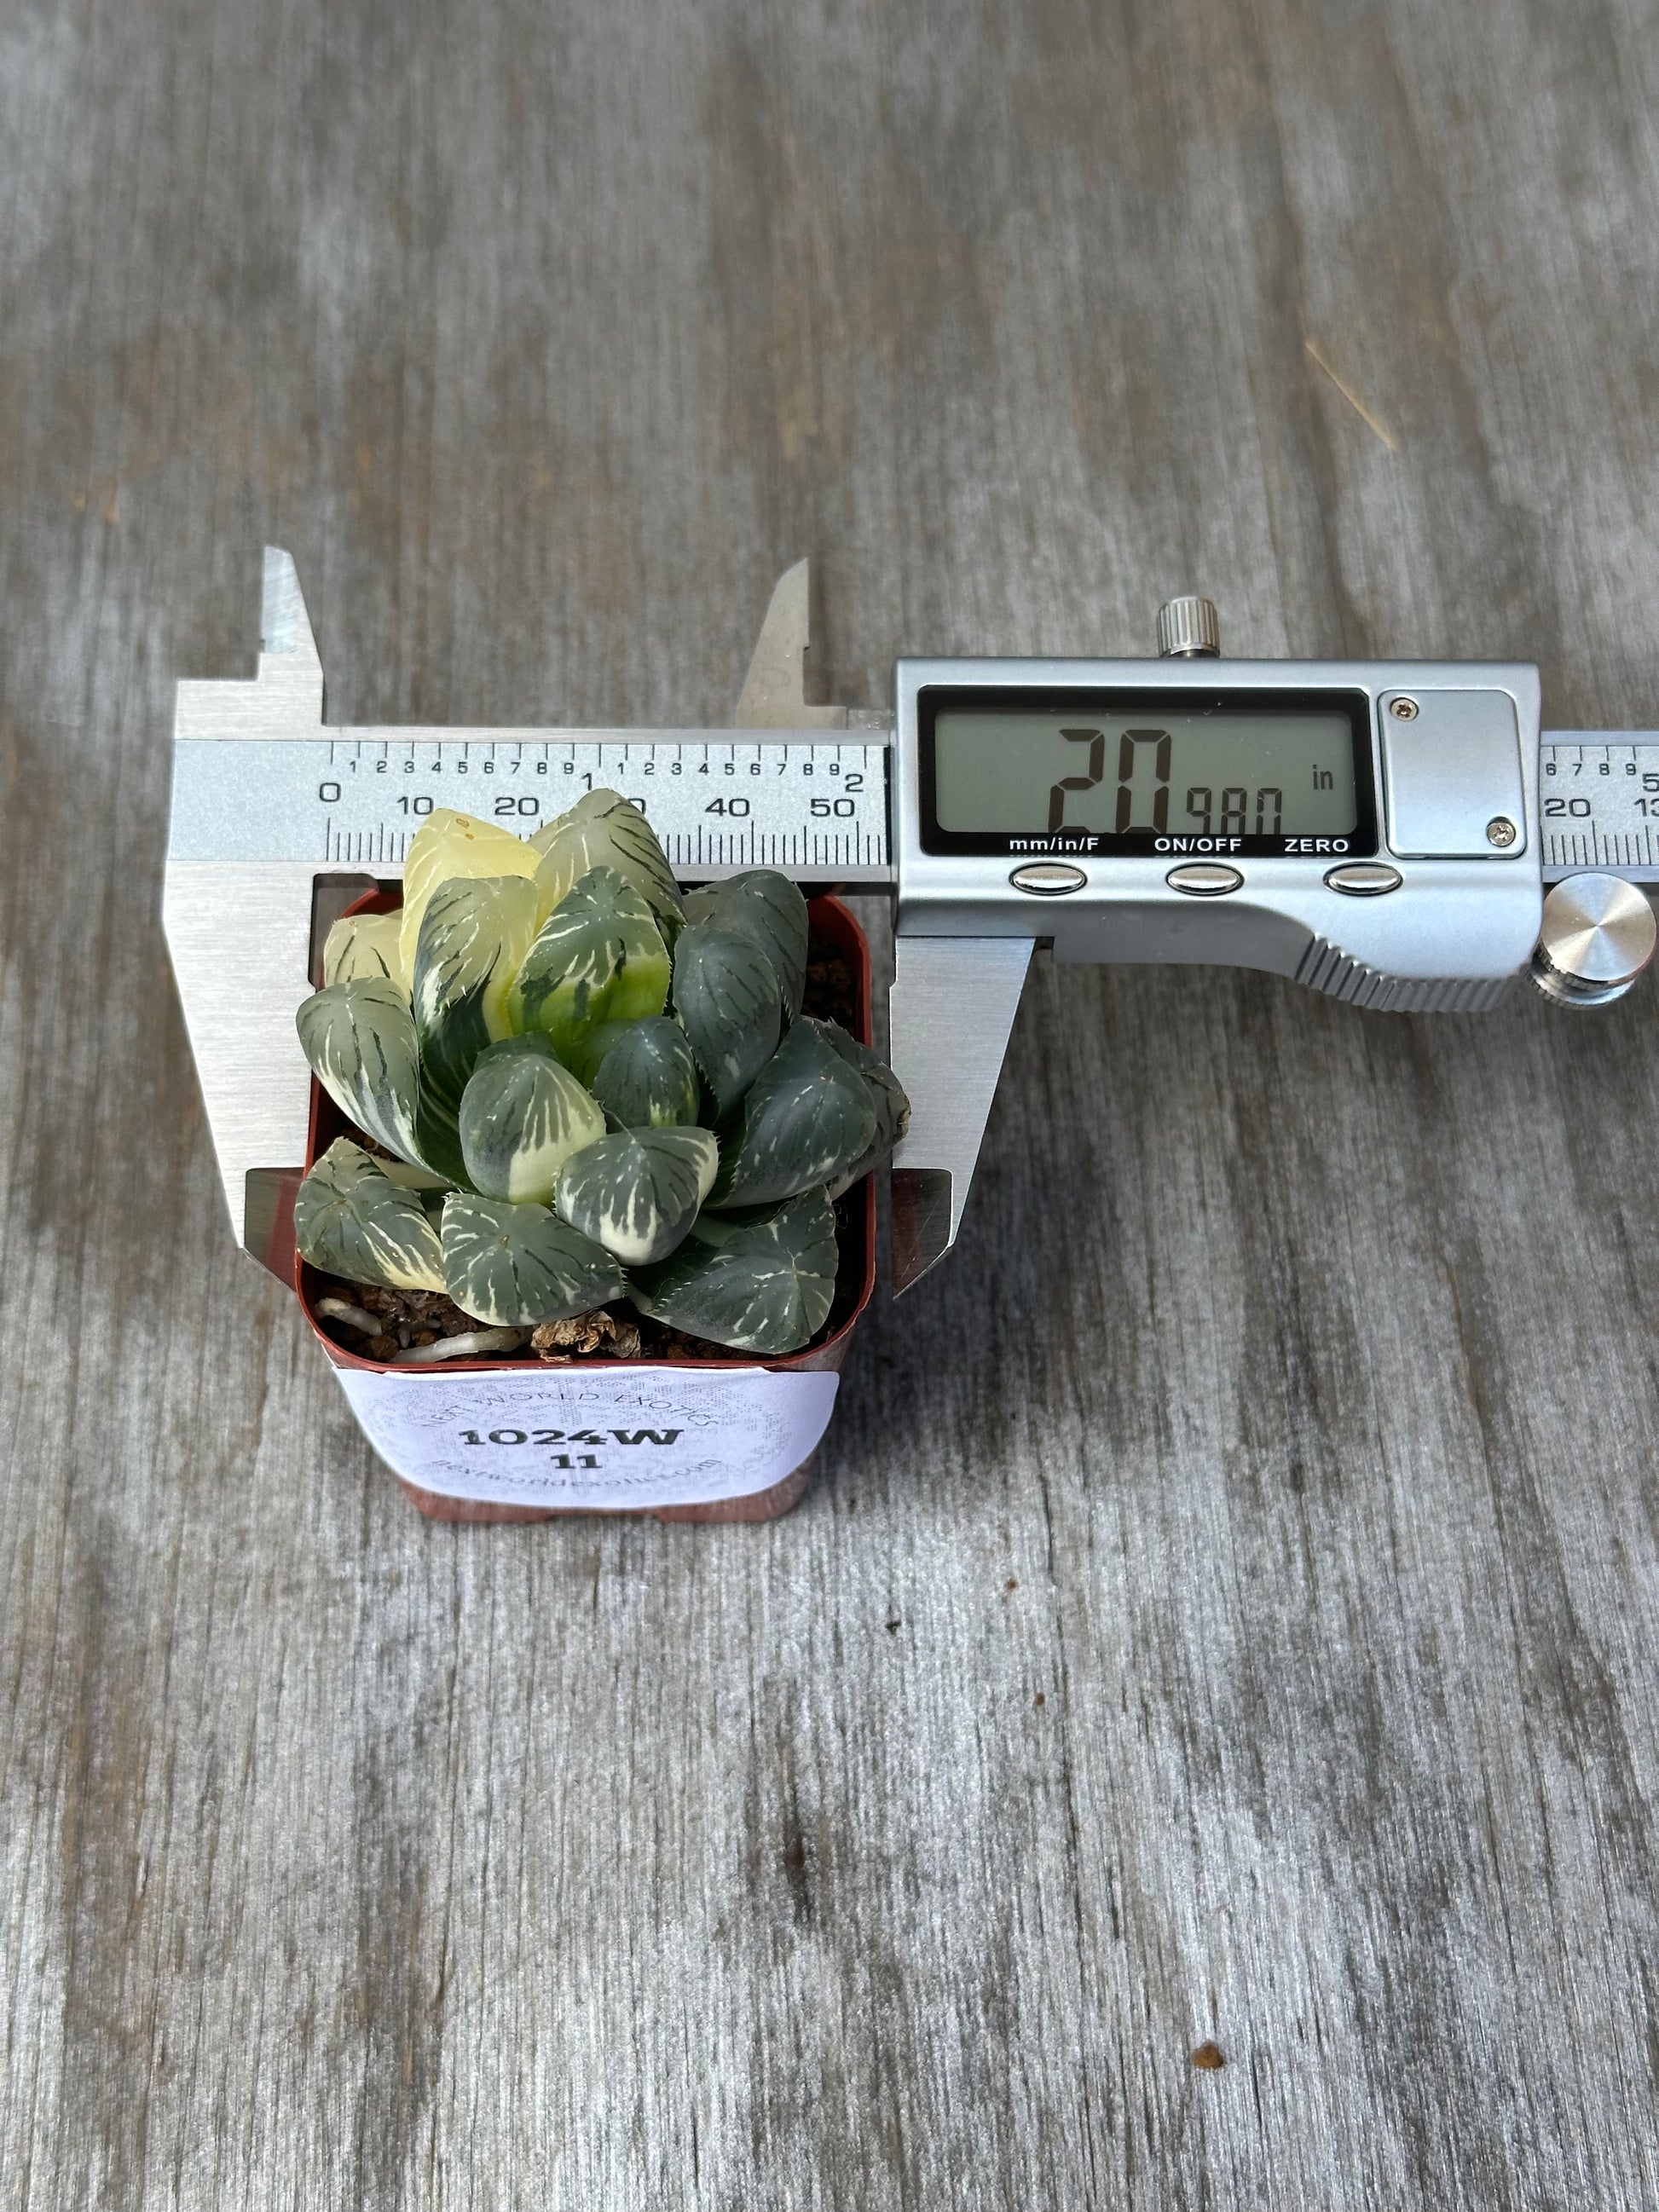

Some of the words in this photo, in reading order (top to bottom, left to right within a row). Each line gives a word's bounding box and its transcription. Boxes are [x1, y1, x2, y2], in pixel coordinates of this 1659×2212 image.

[349, 759, 357, 774] 1
[376, 759, 388, 774] 2
[403, 760, 415, 774] 3
[431, 760, 442, 774] 4
[457, 760, 469, 775] 5
[483, 761, 495, 775] 6
[510, 761, 522, 775] 7
[535, 761, 548, 776] 8
[563, 761, 575, 775] 9
[617, 762, 625, 776] 1
[644, 761, 655, 776] 2
[670, 762, 683, 776] 3
[697, 762, 710, 777] 4
[724, 762, 736, 777] 5
[749, 762, 761, 777] 6
[776, 763, 787, 777] 7
[802, 763, 814, 777] 8
[829, 763, 841, 777] 9
[1545, 762, 1558, 777] 6
[1571, 762, 1583, 777] 7
[1598, 762, 1610, 777] 8
[1625, 762, 1638, 777] 9
[581, 772, 592, 792] 1
[844, 772, 864, 794] 2
[1312, 764, 1333, 790] in
[1641, 772, 1659, 793] 5
[318, 782, 342, 804] 0
[396, 795, 435, 816] 10
[494, 796, 540, 817] 20
[704, 797, 751, 817] 40
[810, 798, 856, 818] 50
[1009, 836, 1100, 851] mm/in/F
[1153, 837, 1242, 852] ON/OFF
[1284, 839, 1350, 852] ZERO
[458, 1429, 685, 1446] 1024W
[550, 1453, 604, 1470] 11
